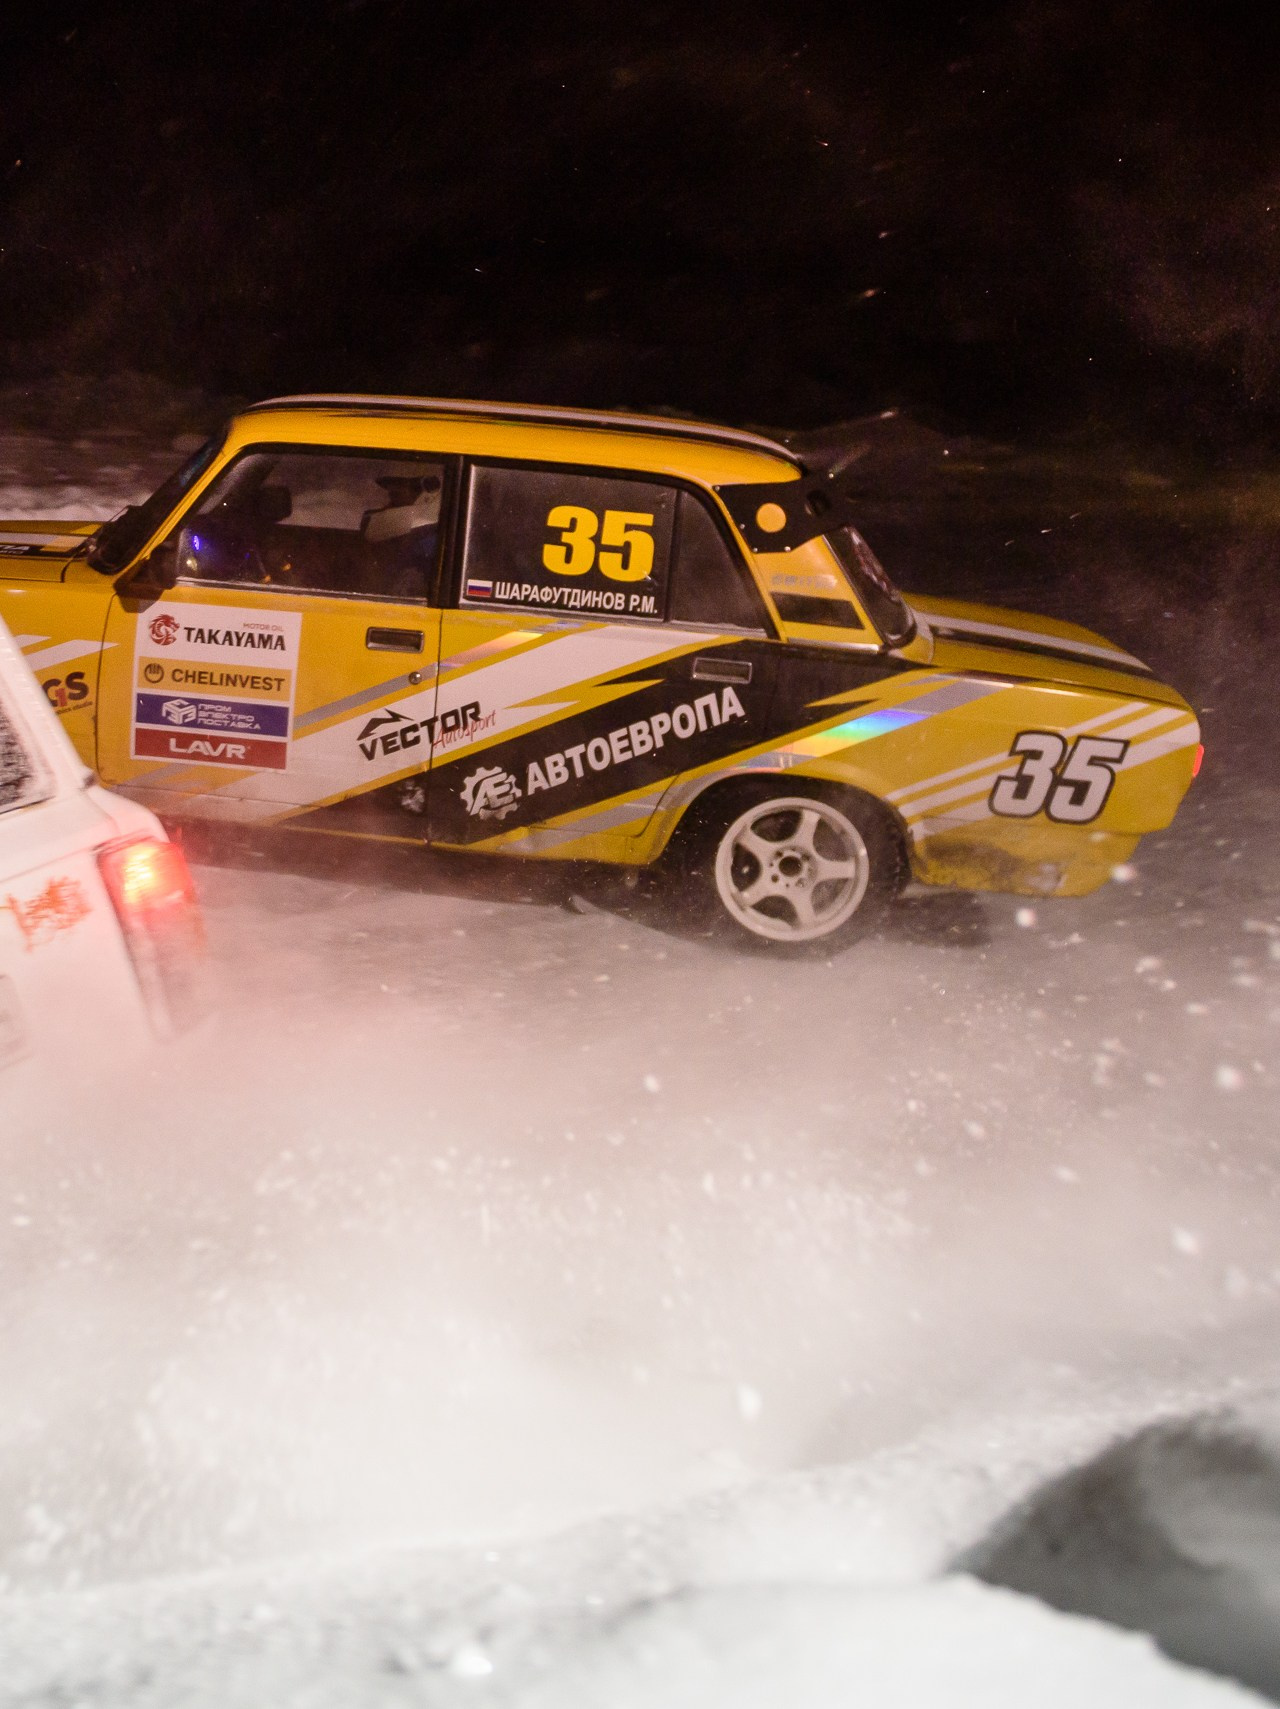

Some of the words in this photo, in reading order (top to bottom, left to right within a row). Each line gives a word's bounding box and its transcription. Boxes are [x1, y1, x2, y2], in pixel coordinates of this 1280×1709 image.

[543, 505, 655, 582] 35
[495, 582, 625, 611] ШАРАФУТДИНОВ
[629, 595, 658, 614] Р.М.
[184, 627, 286, 651] TAKAYAMA
[171, 668, 285, 692] CHELINVEST
[198, 703, 232, 712] ПРОМ
[197, 718, 261, 729] ПОСТАВКА
[358, 701, 482, 761] VECTOR
[170, 737, 246, 759] LAVR
[526, 686, 746, 795] АВТОЕВРОПА
[987, 730, 1130, 825] 35
